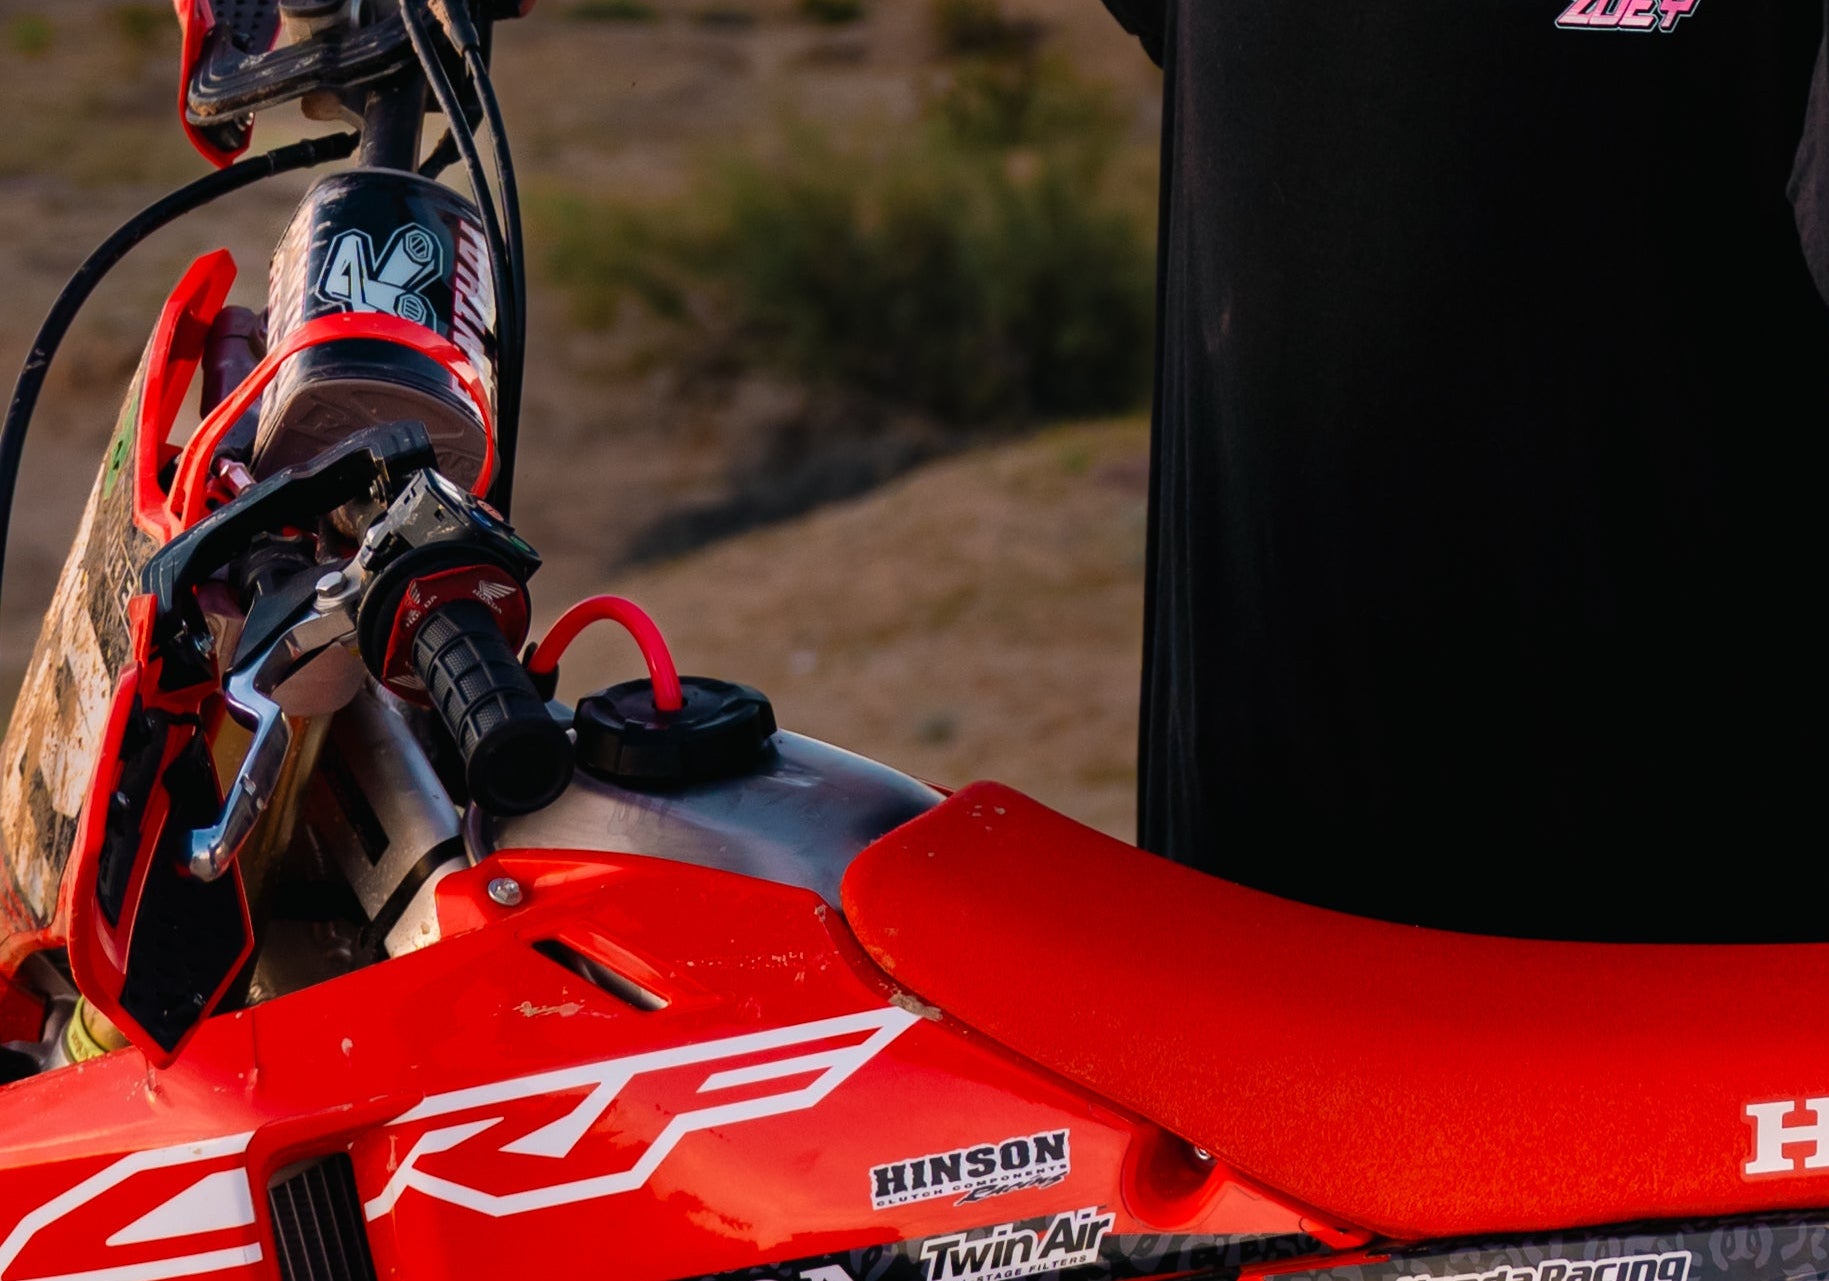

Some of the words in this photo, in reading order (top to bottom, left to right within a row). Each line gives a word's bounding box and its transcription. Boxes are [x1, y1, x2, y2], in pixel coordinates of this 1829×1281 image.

[873, 1131, 1066, 1198] HINSON
[876, 1188, 944, 1207] CLUTCH
[952, 1163, 1067, 1192] COMPONENTS
[926, 1229, 1035, 1281] Twin
[1037, 1212, 1111, 1260] Air
[1029, 1254, 1087, 1273] FILTERS
